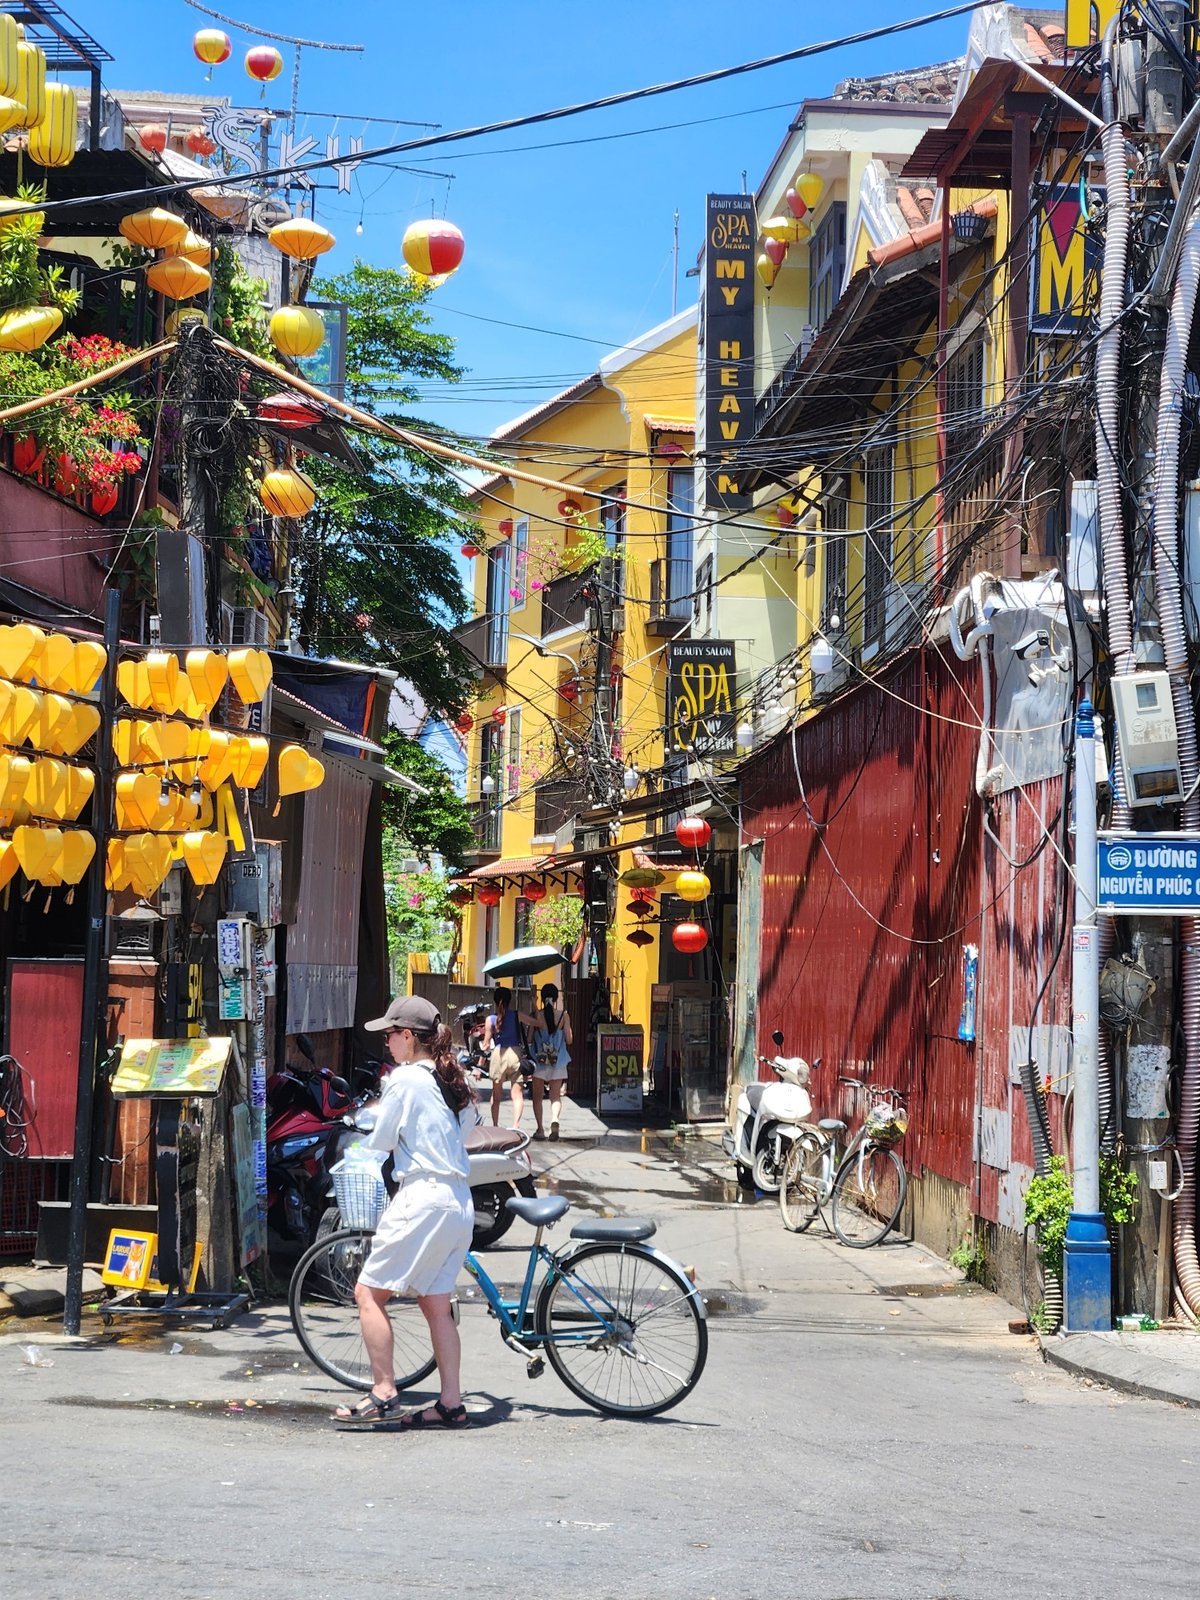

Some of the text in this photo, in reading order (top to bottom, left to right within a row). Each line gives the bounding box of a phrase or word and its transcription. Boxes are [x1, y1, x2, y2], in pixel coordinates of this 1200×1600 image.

[711, 200, 752, 210] BEAUTY SALON
[711, 213, 750, 249] SPA
[716, 259, 745, 306] MY
[673, 646, 732, 657] BEAUTY SALON
[673, 661, 732, 750] SPA
[707, 719, 722, 733] MY
[1134, 844, 1198, 869] ĐƯỜNG
[1100, 870, 1154, 895] NGUYỄN
[1156, 874, 1193, 896] PHÚC
[606, 1055, 640, 1076] SPA
